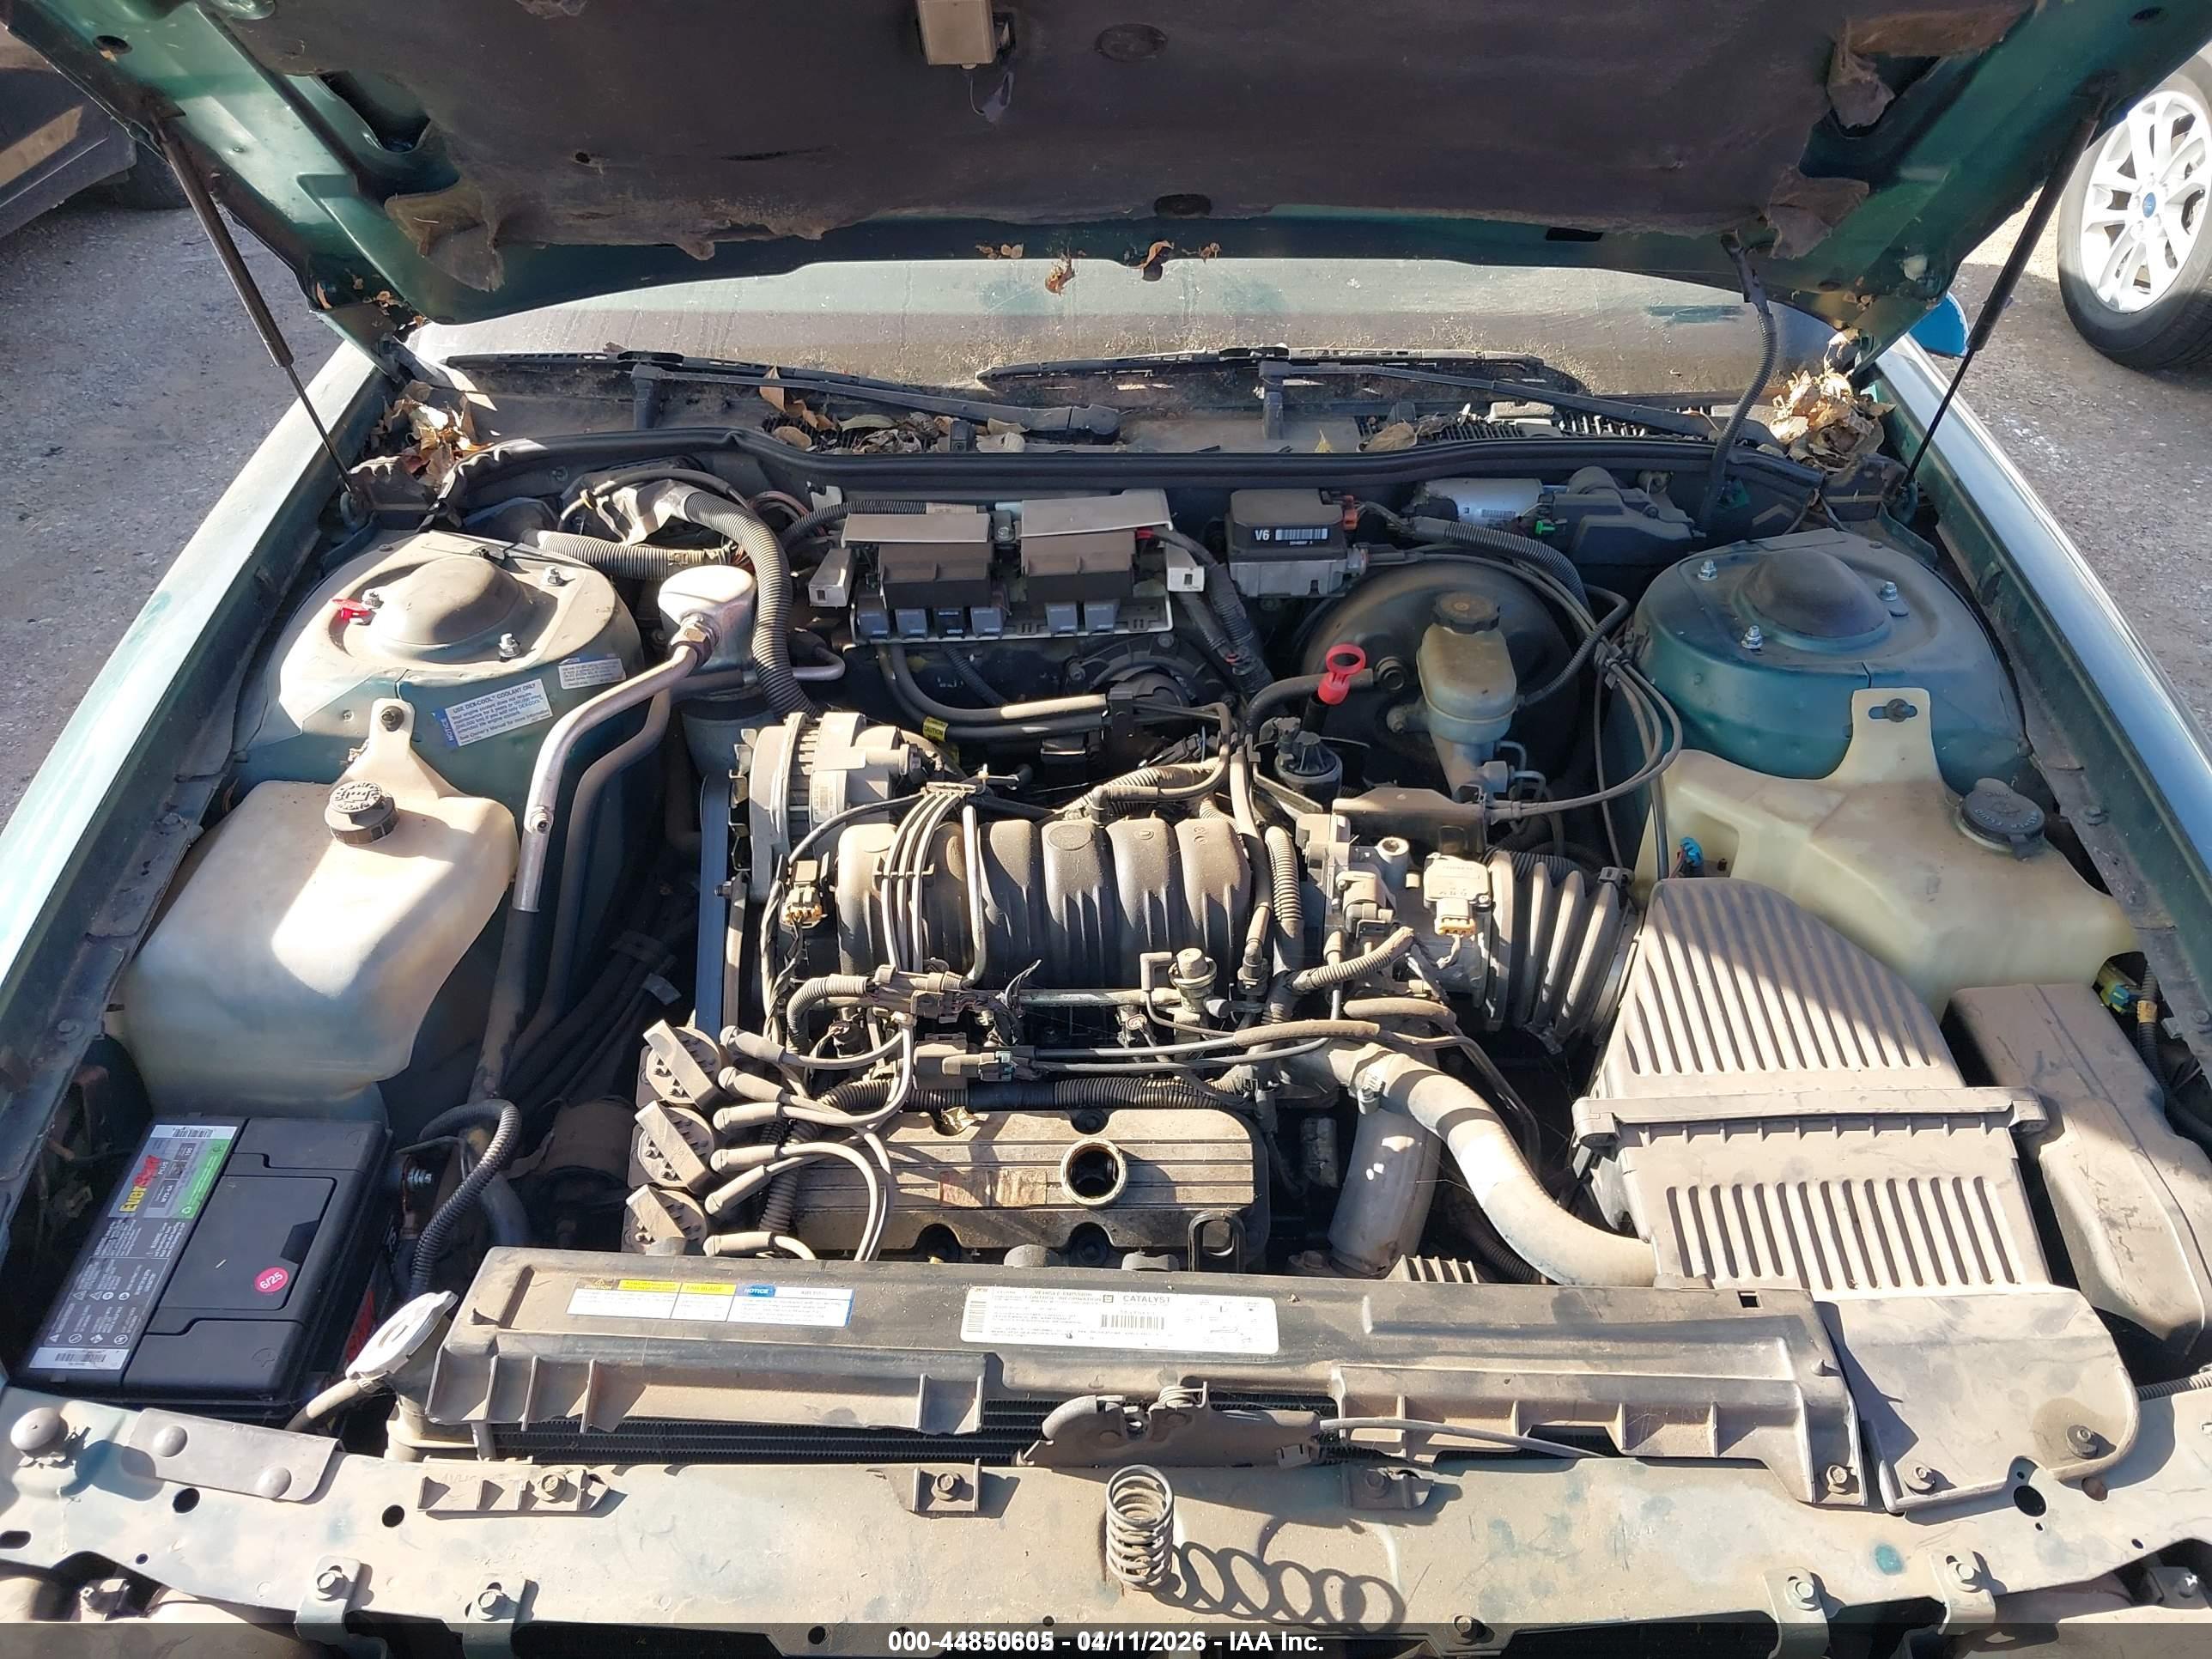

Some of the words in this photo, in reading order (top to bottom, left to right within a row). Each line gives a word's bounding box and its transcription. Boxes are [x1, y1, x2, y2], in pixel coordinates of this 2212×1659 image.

[1255, 529, 1270, 540] V6
[496, 688, 521, 699] COOLANT
[158, 1161, 169, 1175] PLUS
[259, 1272, 283, 1289] 6/25
[1123, 1295, 1171, 1304] CATALYST
